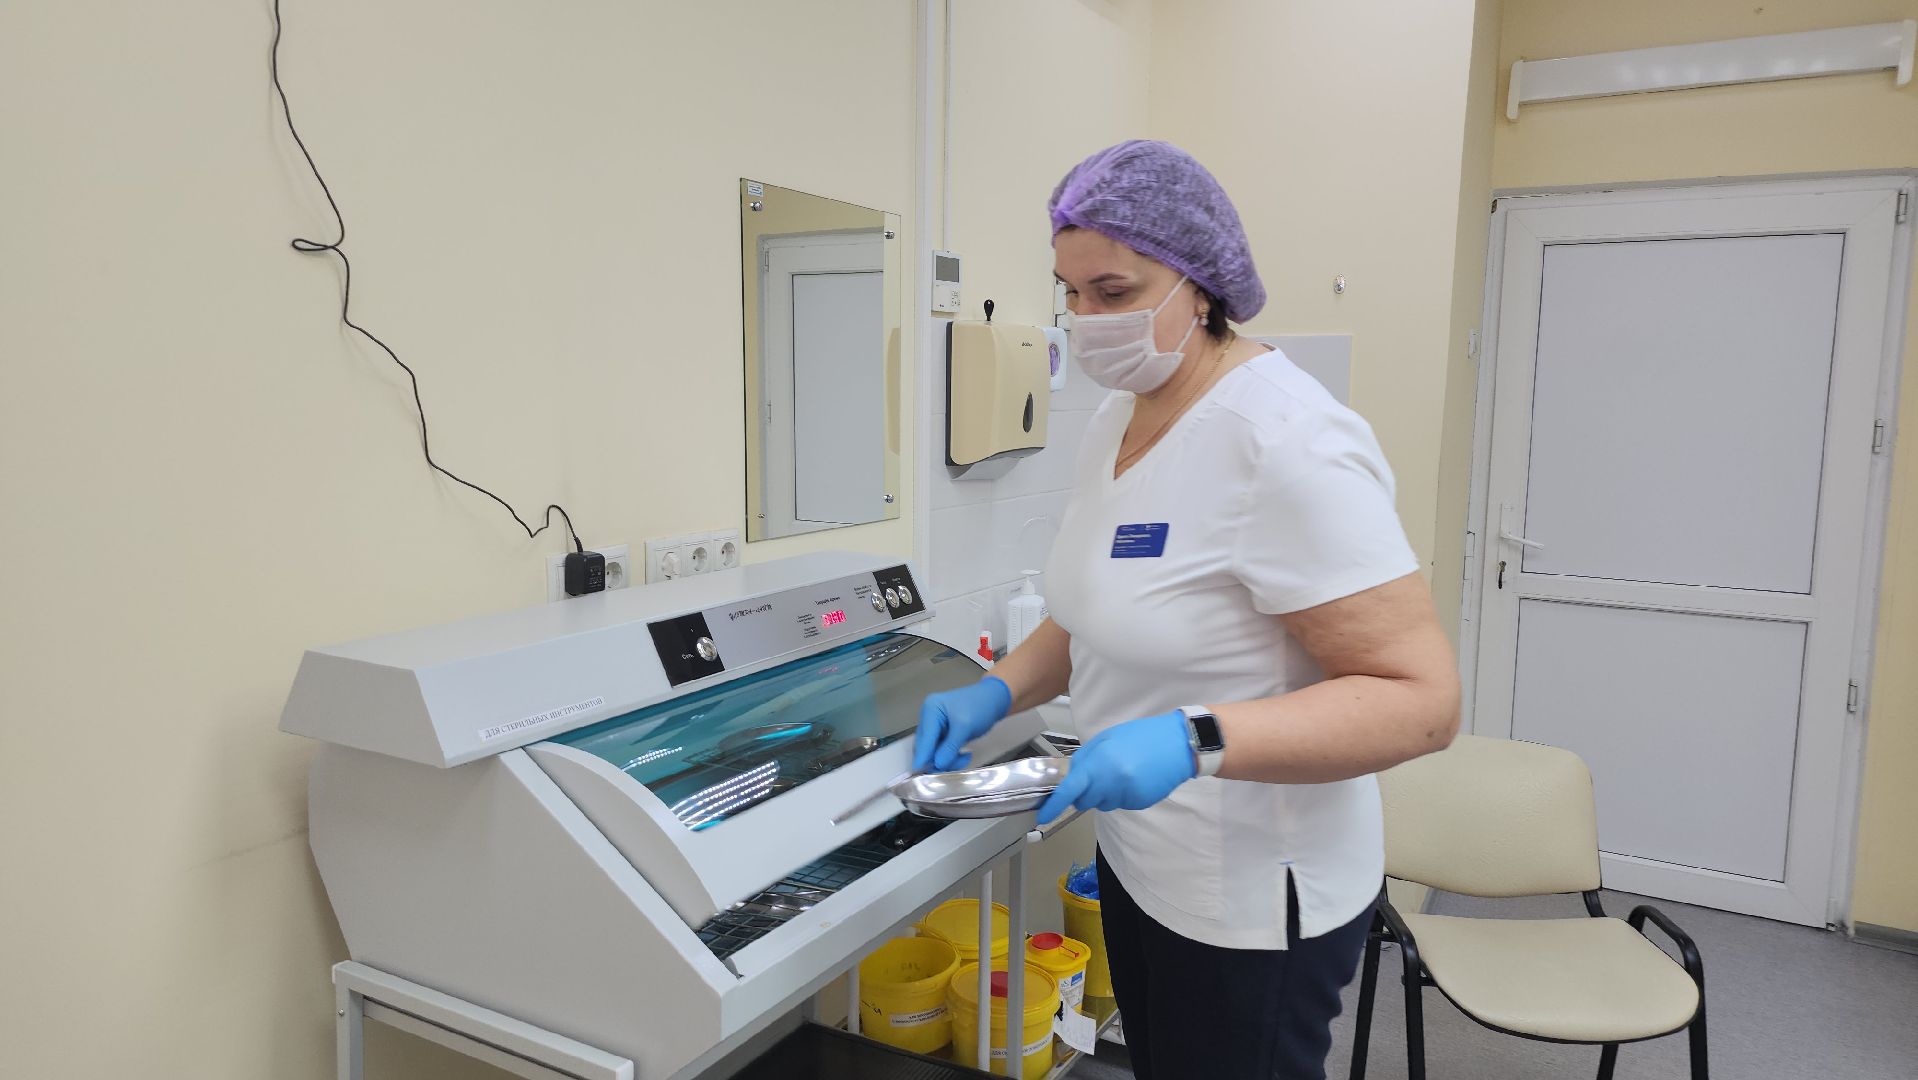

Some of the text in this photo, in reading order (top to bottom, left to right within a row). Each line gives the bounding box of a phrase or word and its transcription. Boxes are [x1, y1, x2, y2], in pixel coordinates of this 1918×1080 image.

[485, 697, 604, 739] ДЛЯ СТЕРИЛЬНЫХ ИНСТРУМЕНТОВ
